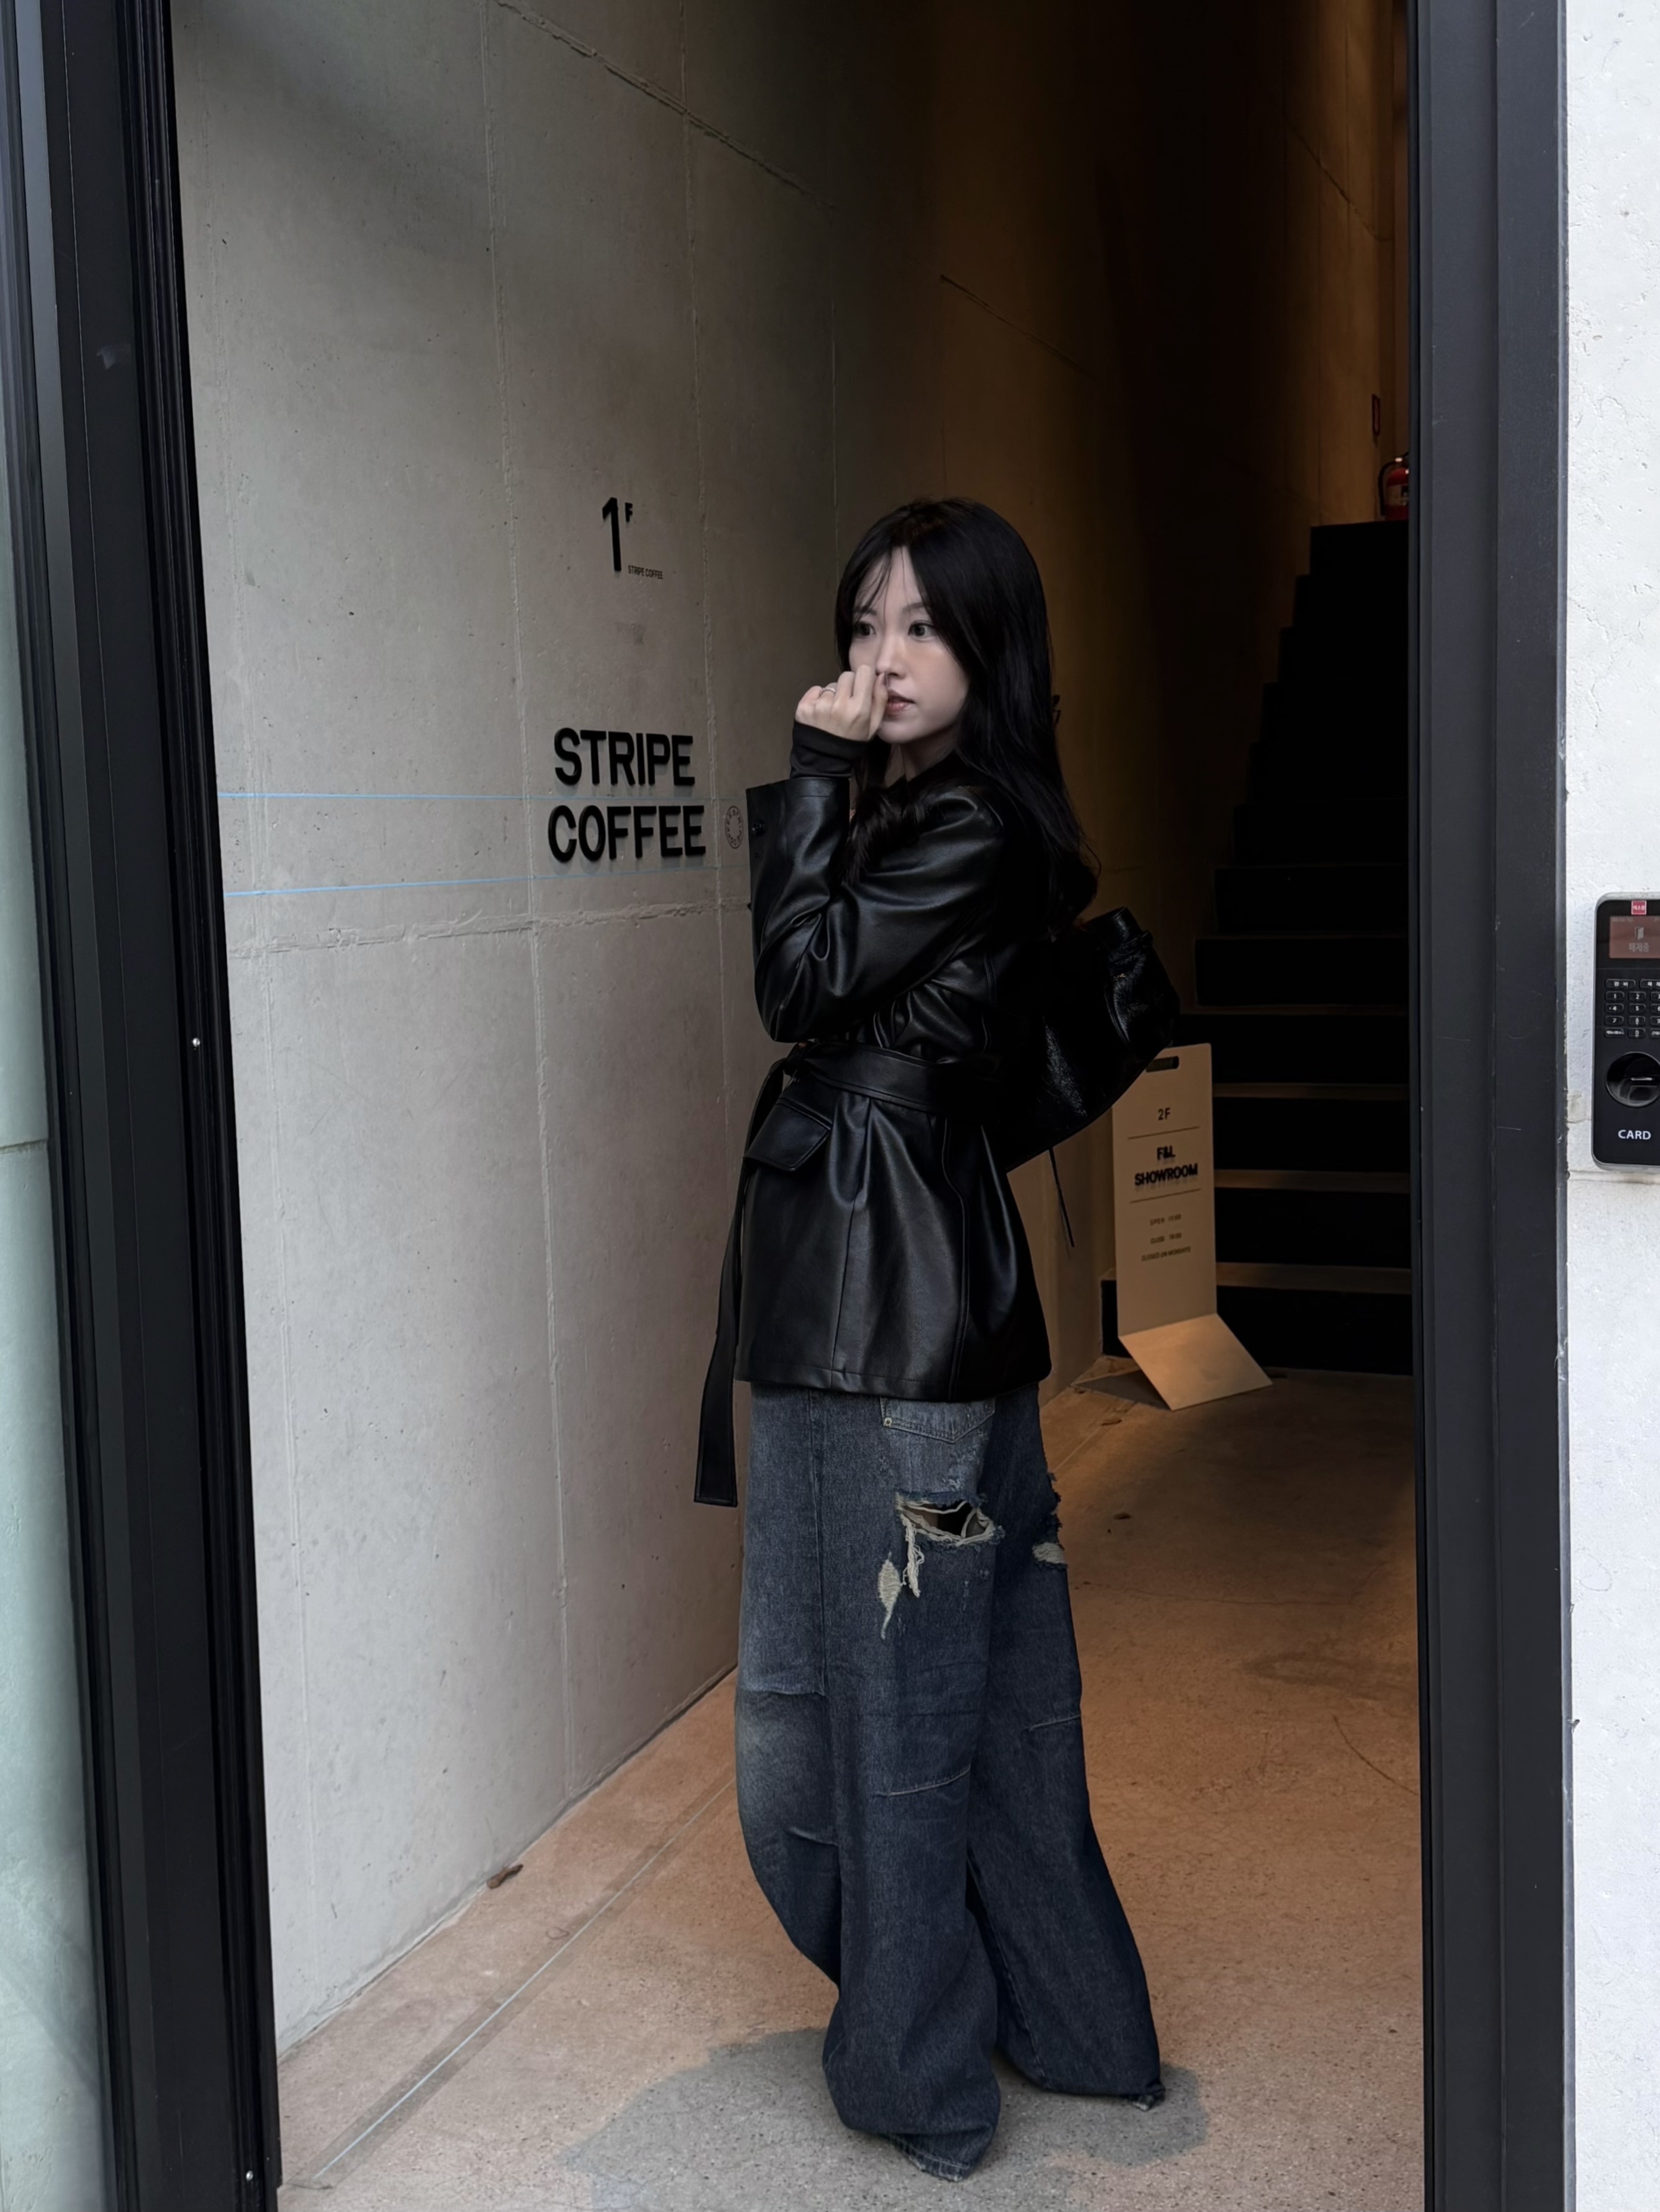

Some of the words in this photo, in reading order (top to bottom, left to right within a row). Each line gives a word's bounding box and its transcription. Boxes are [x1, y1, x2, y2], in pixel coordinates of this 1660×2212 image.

[628, 565, 645, 577] STRIPE
[645, 568, 664, 580] COFFEE
[554, 727, 695, 786] STRIPE
[548, 805, 706, 863] COFFEE
[1158, 1107, 1171, 1121] 2F
[1618, 1130, 1651, 1140] CARD
[1134, 1162, 1198, 1186] SHOWROOM
